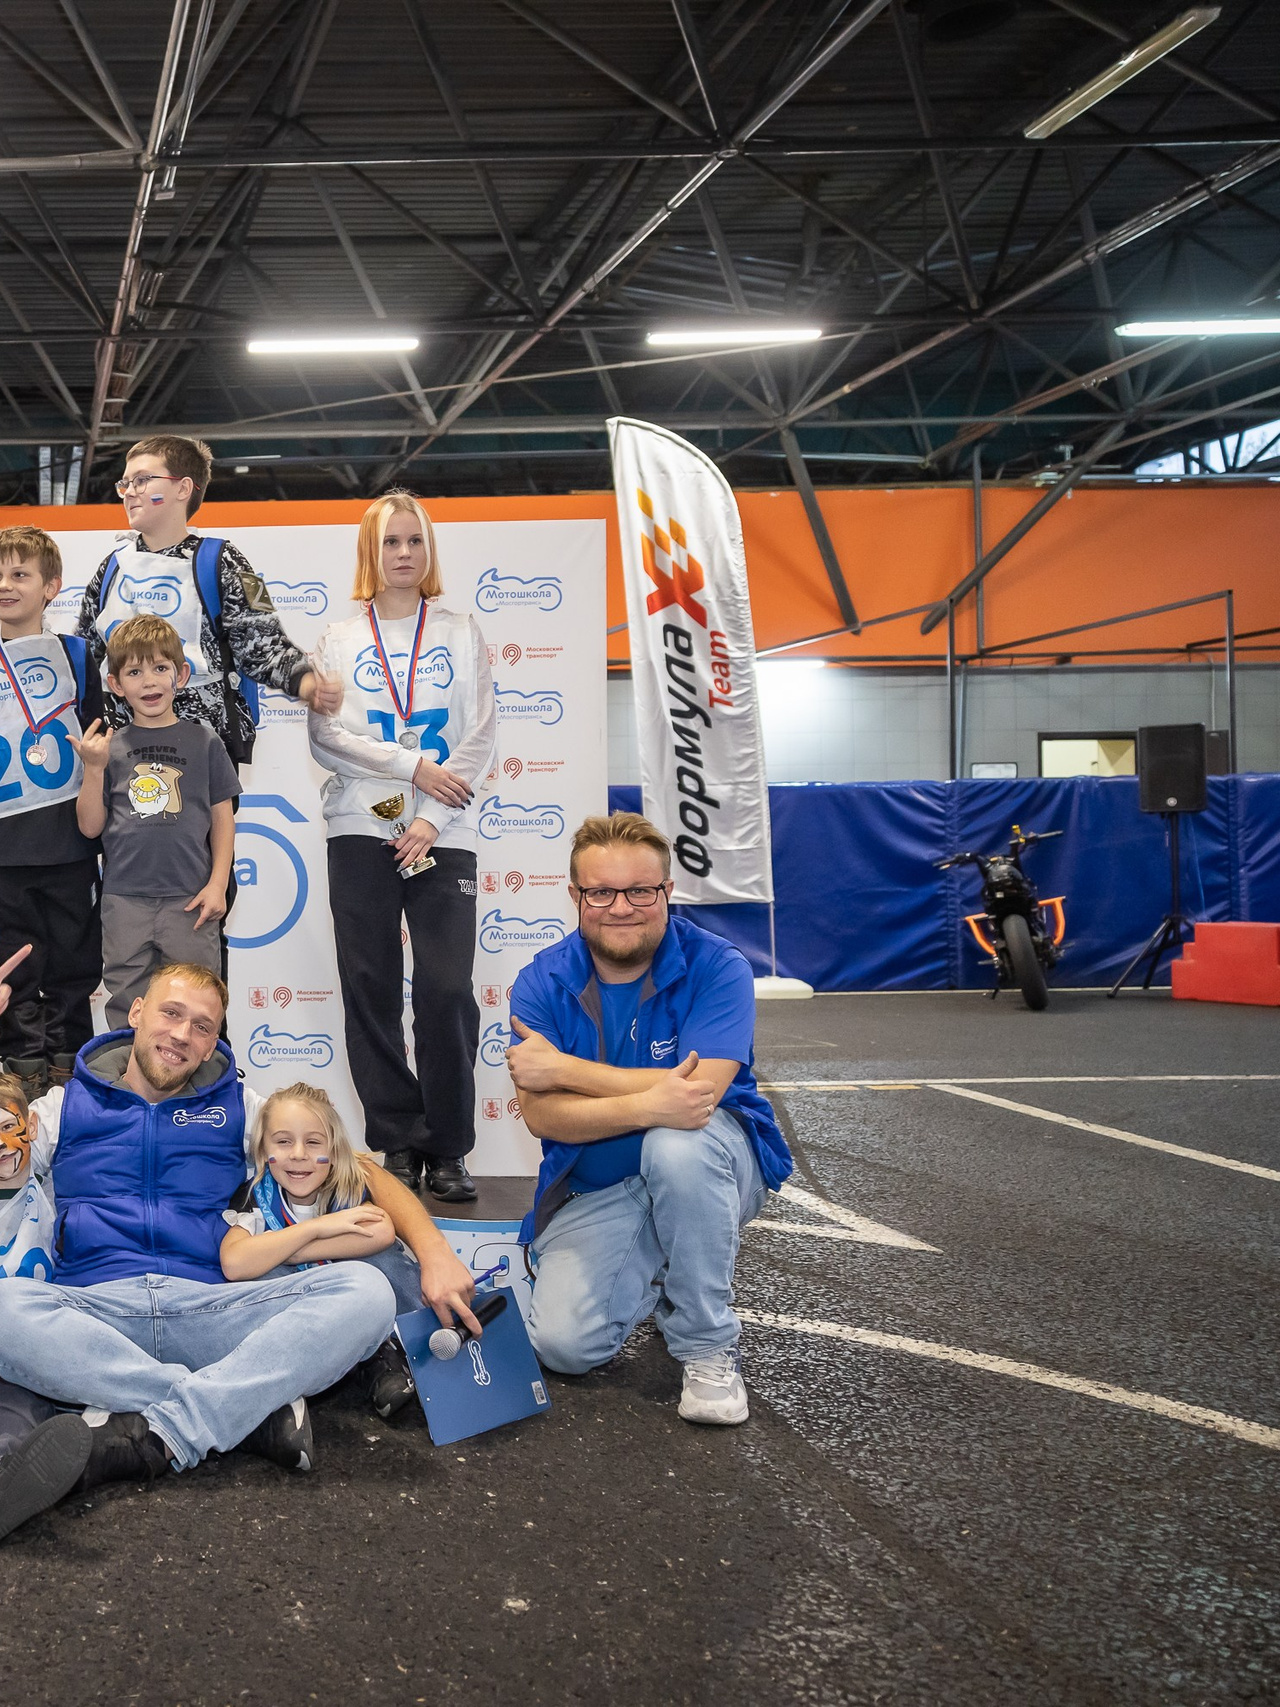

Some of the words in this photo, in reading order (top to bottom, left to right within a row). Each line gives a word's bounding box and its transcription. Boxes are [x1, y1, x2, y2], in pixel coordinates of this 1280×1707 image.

[485, 589, 552, 600] Мотошкола
[708, 630, 734, 709] Team
[126, 745, 178, 759] FOREVER
[662, 623, 720, 879] Формула
[141, 753, 188, 766] FRIENDS
[487, 817, 554, 827] Мотошкола
[488, 930, 555, 941] Мотошкола
[257, 1046, 323, 1056] Мотошкола
